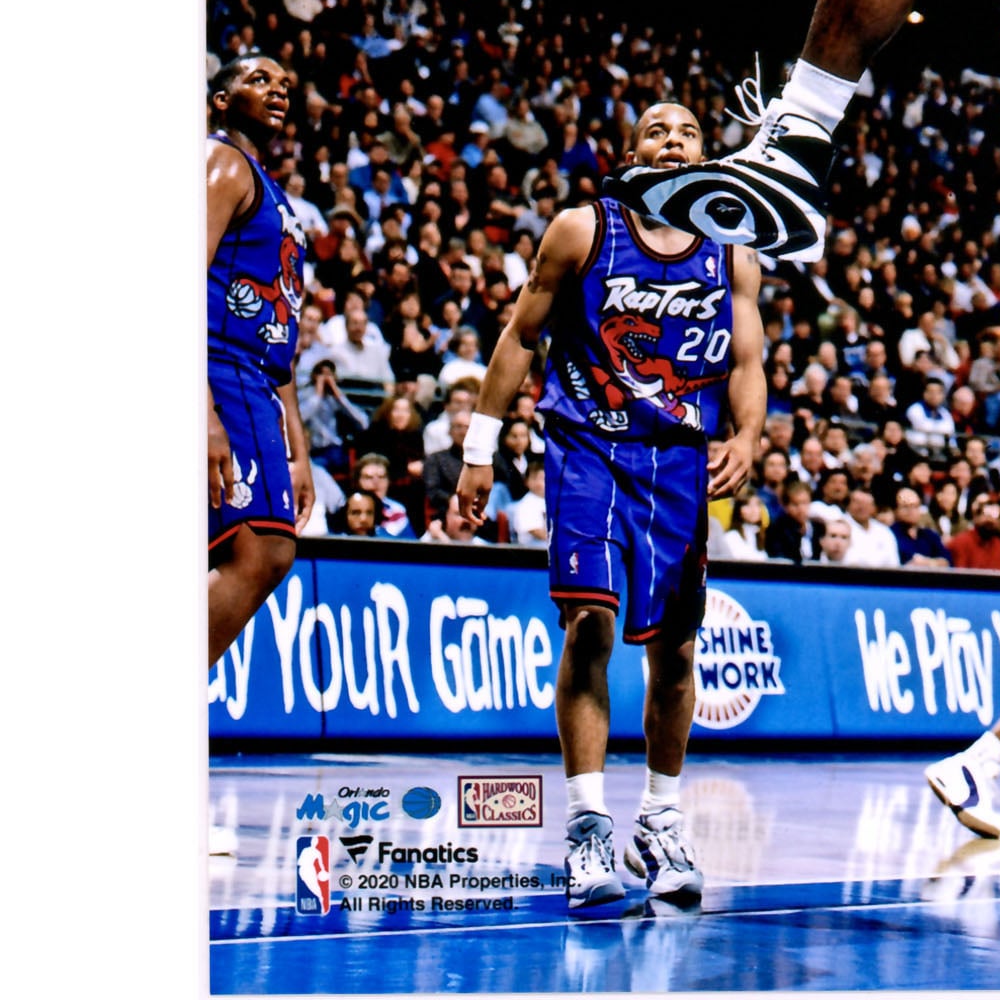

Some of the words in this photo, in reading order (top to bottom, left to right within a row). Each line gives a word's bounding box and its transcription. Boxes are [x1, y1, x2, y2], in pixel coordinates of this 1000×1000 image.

[676, 326, 732, 364] 20
[698, 626, 769, 654] SHINE
[698, 662, 778, 690] WORK
[854, 608, 915, 715] We
